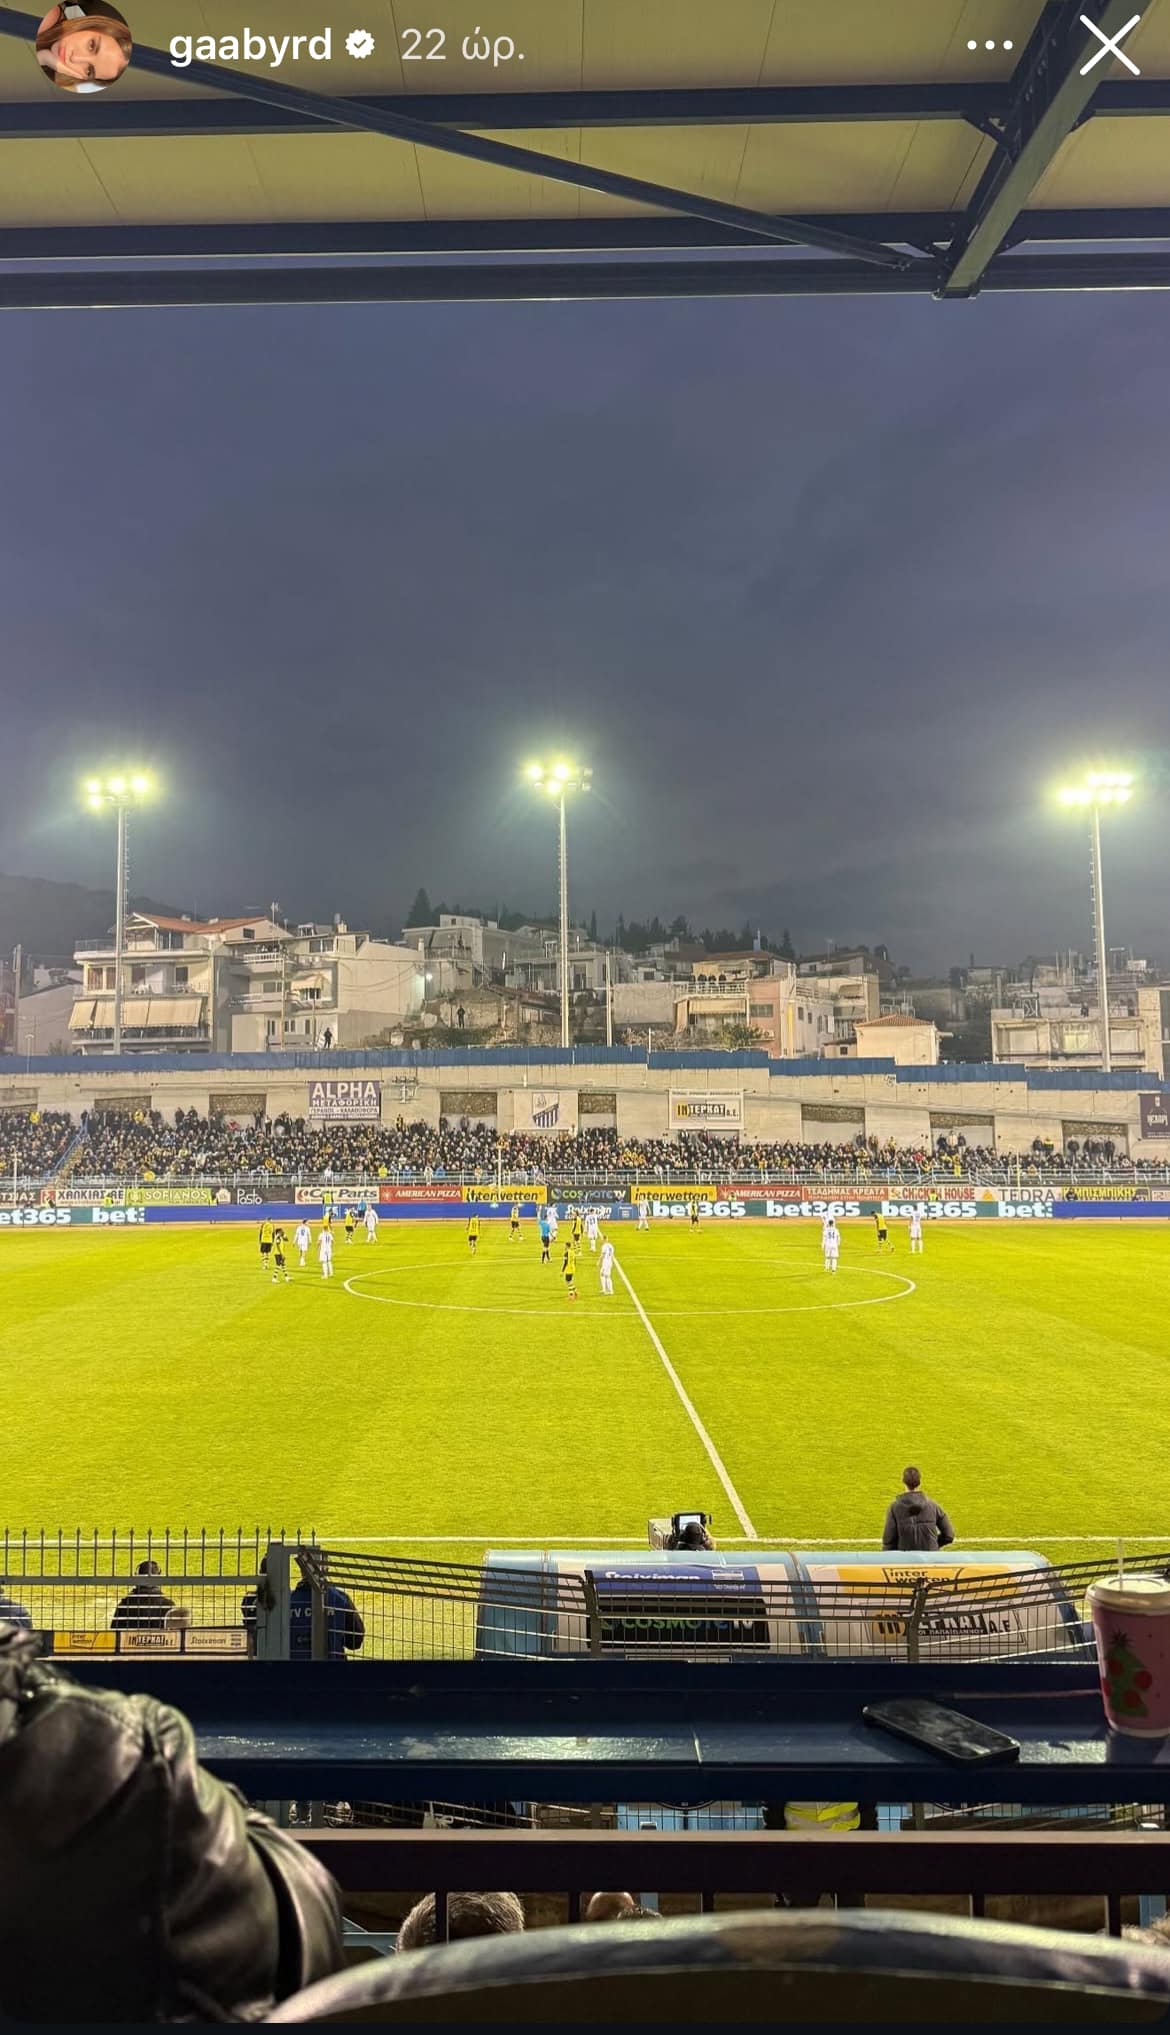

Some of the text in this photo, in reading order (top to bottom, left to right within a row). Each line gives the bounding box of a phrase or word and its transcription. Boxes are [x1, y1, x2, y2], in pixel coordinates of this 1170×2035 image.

[312, 1082, 377, 1098] ALPHA
[145, 1190, 207, 1200] SOFIANOS
[338, 1188, 377, 1198] Parts
[395, 1190, 461, 1198] AMERICAN PIZZA
[467, 1188, 538, 1202] iterwetten
[635, 1188, 709, 1201] interwetten
[734, 1190, 775, 1198] AMERICAN
[775, 1190, 800, 1198] PIZZA
[902, 1187, 975, 1200] CHICKN HOUSE
[767, 1200, 860, 1217] bet365
[881, 1200, 977, 1217] bet365
[890, 1569, 928, 1577] inter
